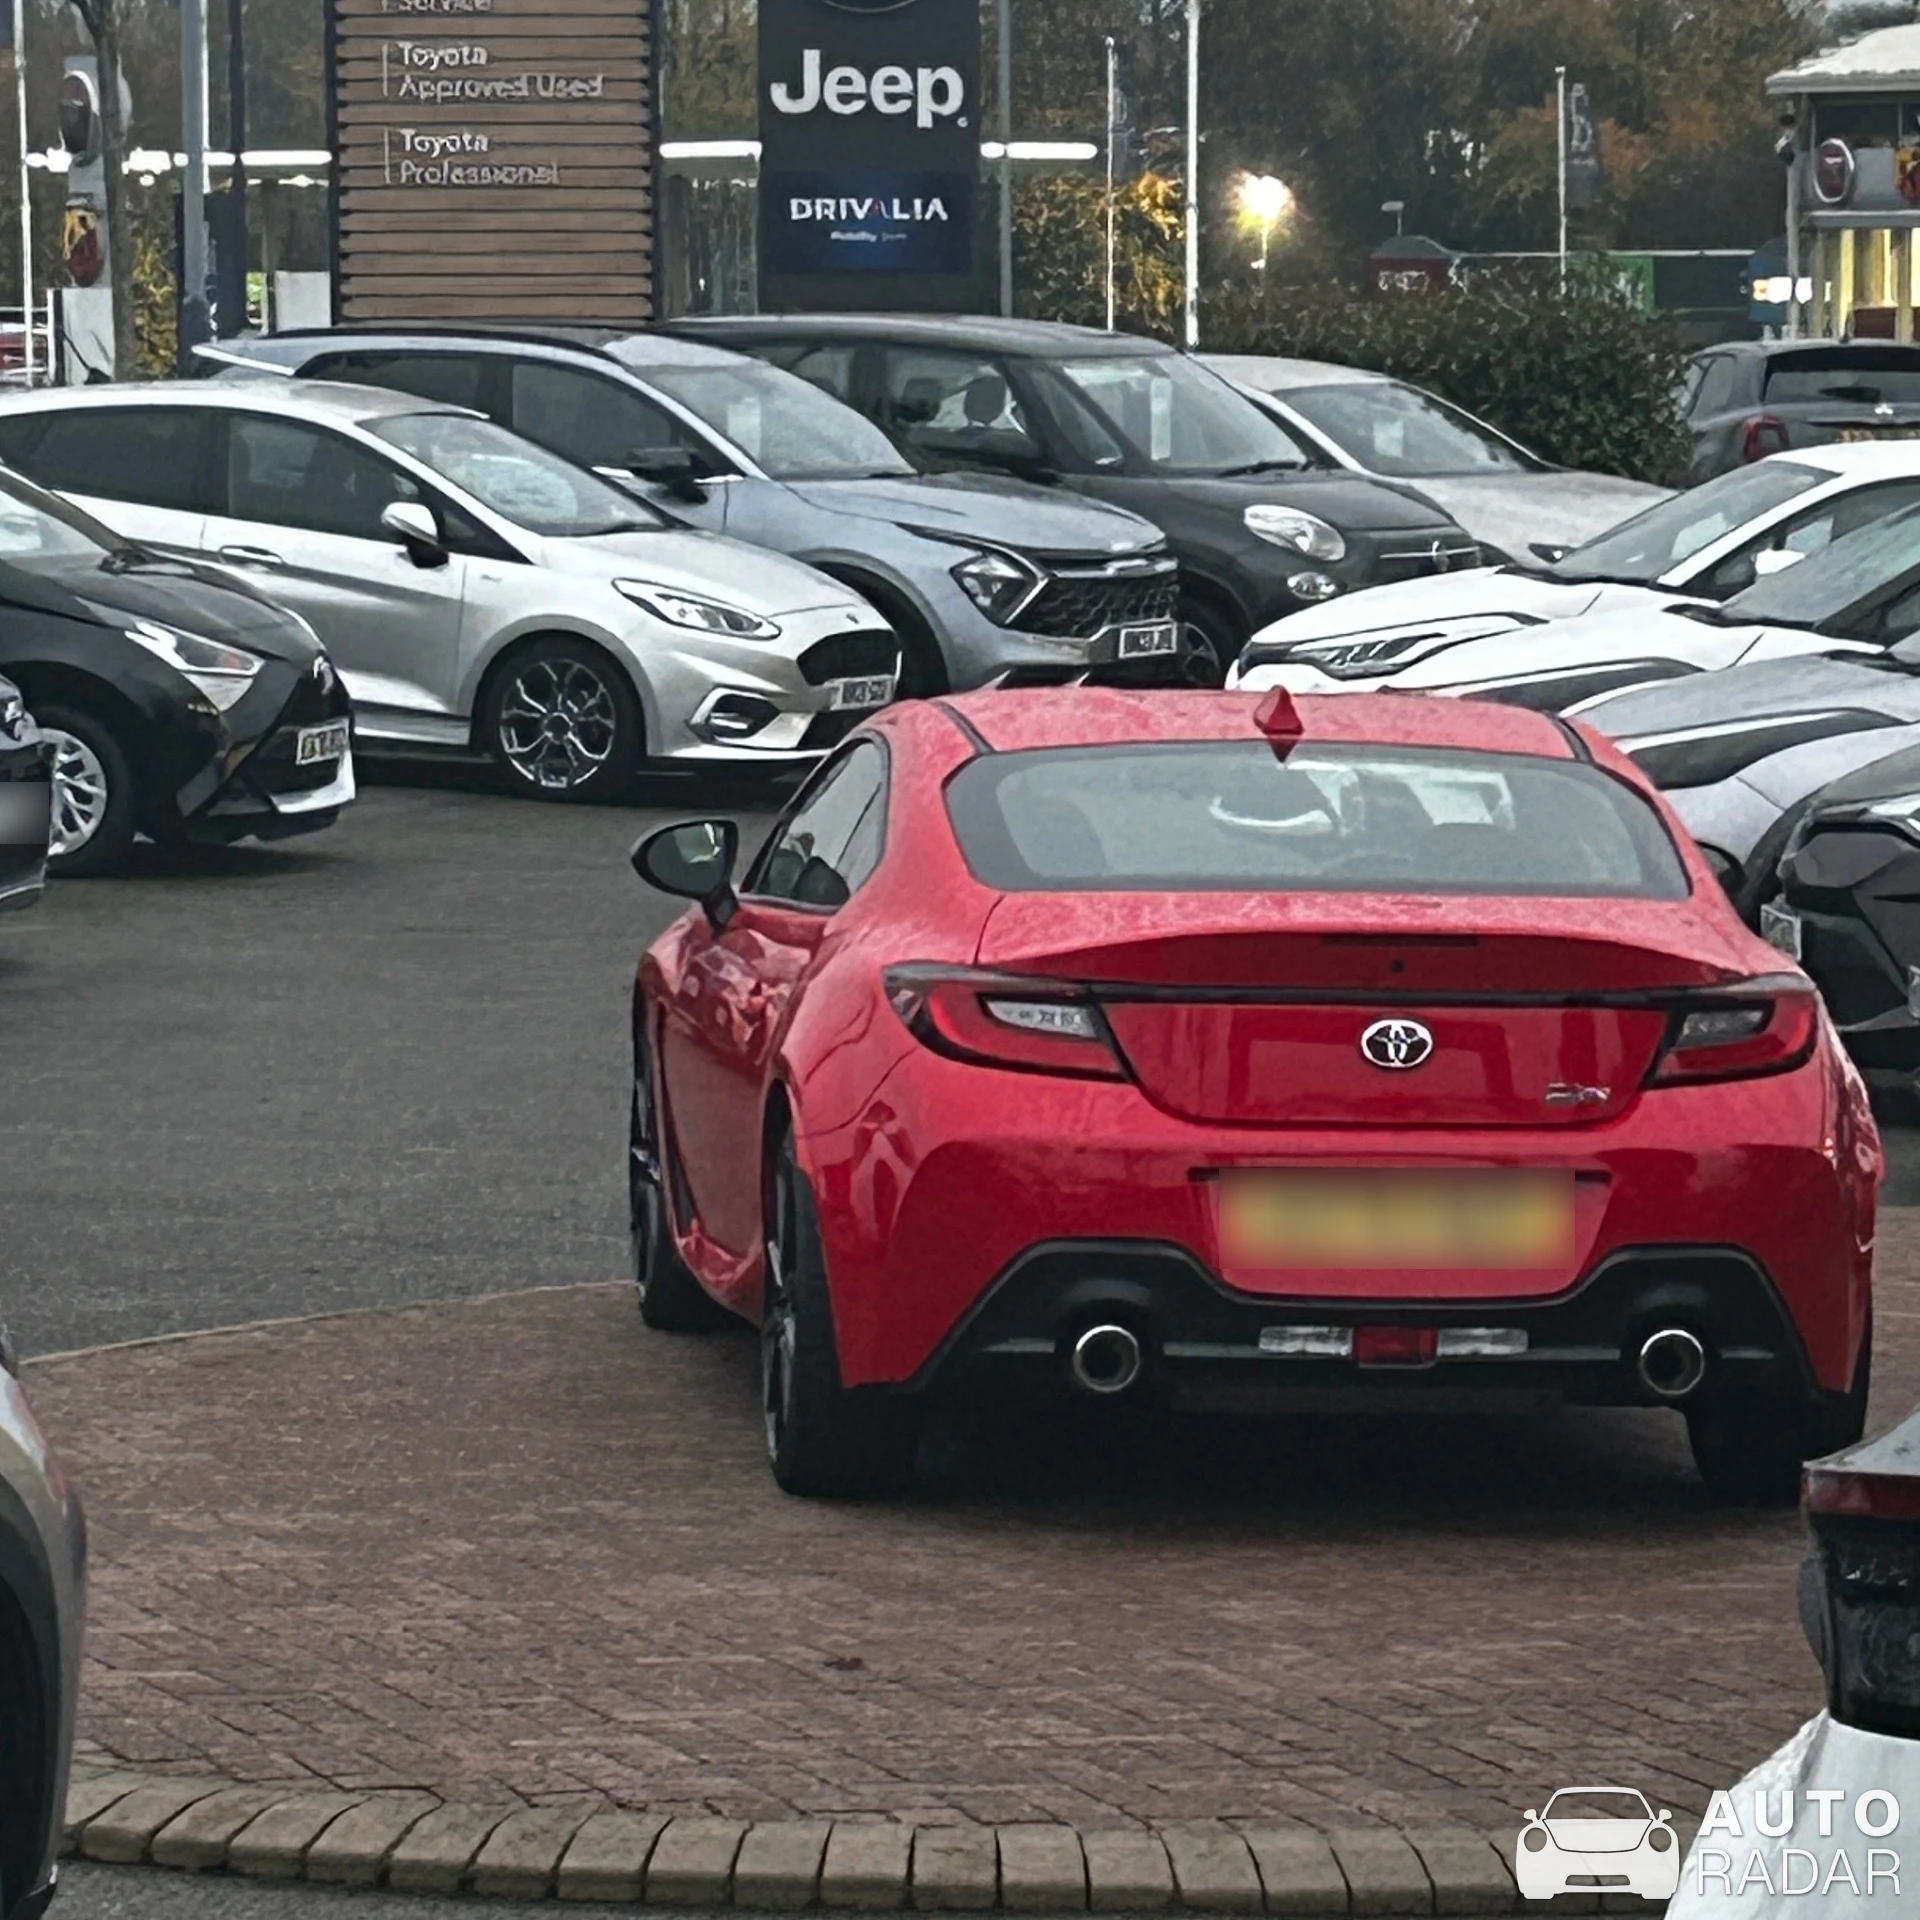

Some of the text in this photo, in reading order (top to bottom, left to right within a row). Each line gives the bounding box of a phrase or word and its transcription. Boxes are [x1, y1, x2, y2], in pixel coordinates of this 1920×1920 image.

[397, 41, 488, 71] Toyota
[399, 74, 604, 103] Approved Used
[770, 49, 964, 128] Jeep
[400, 128, 489, 158] Toyota
[401, 160, 560, 185] Professional
[789, 198, 949, 221] DRIVALIA
